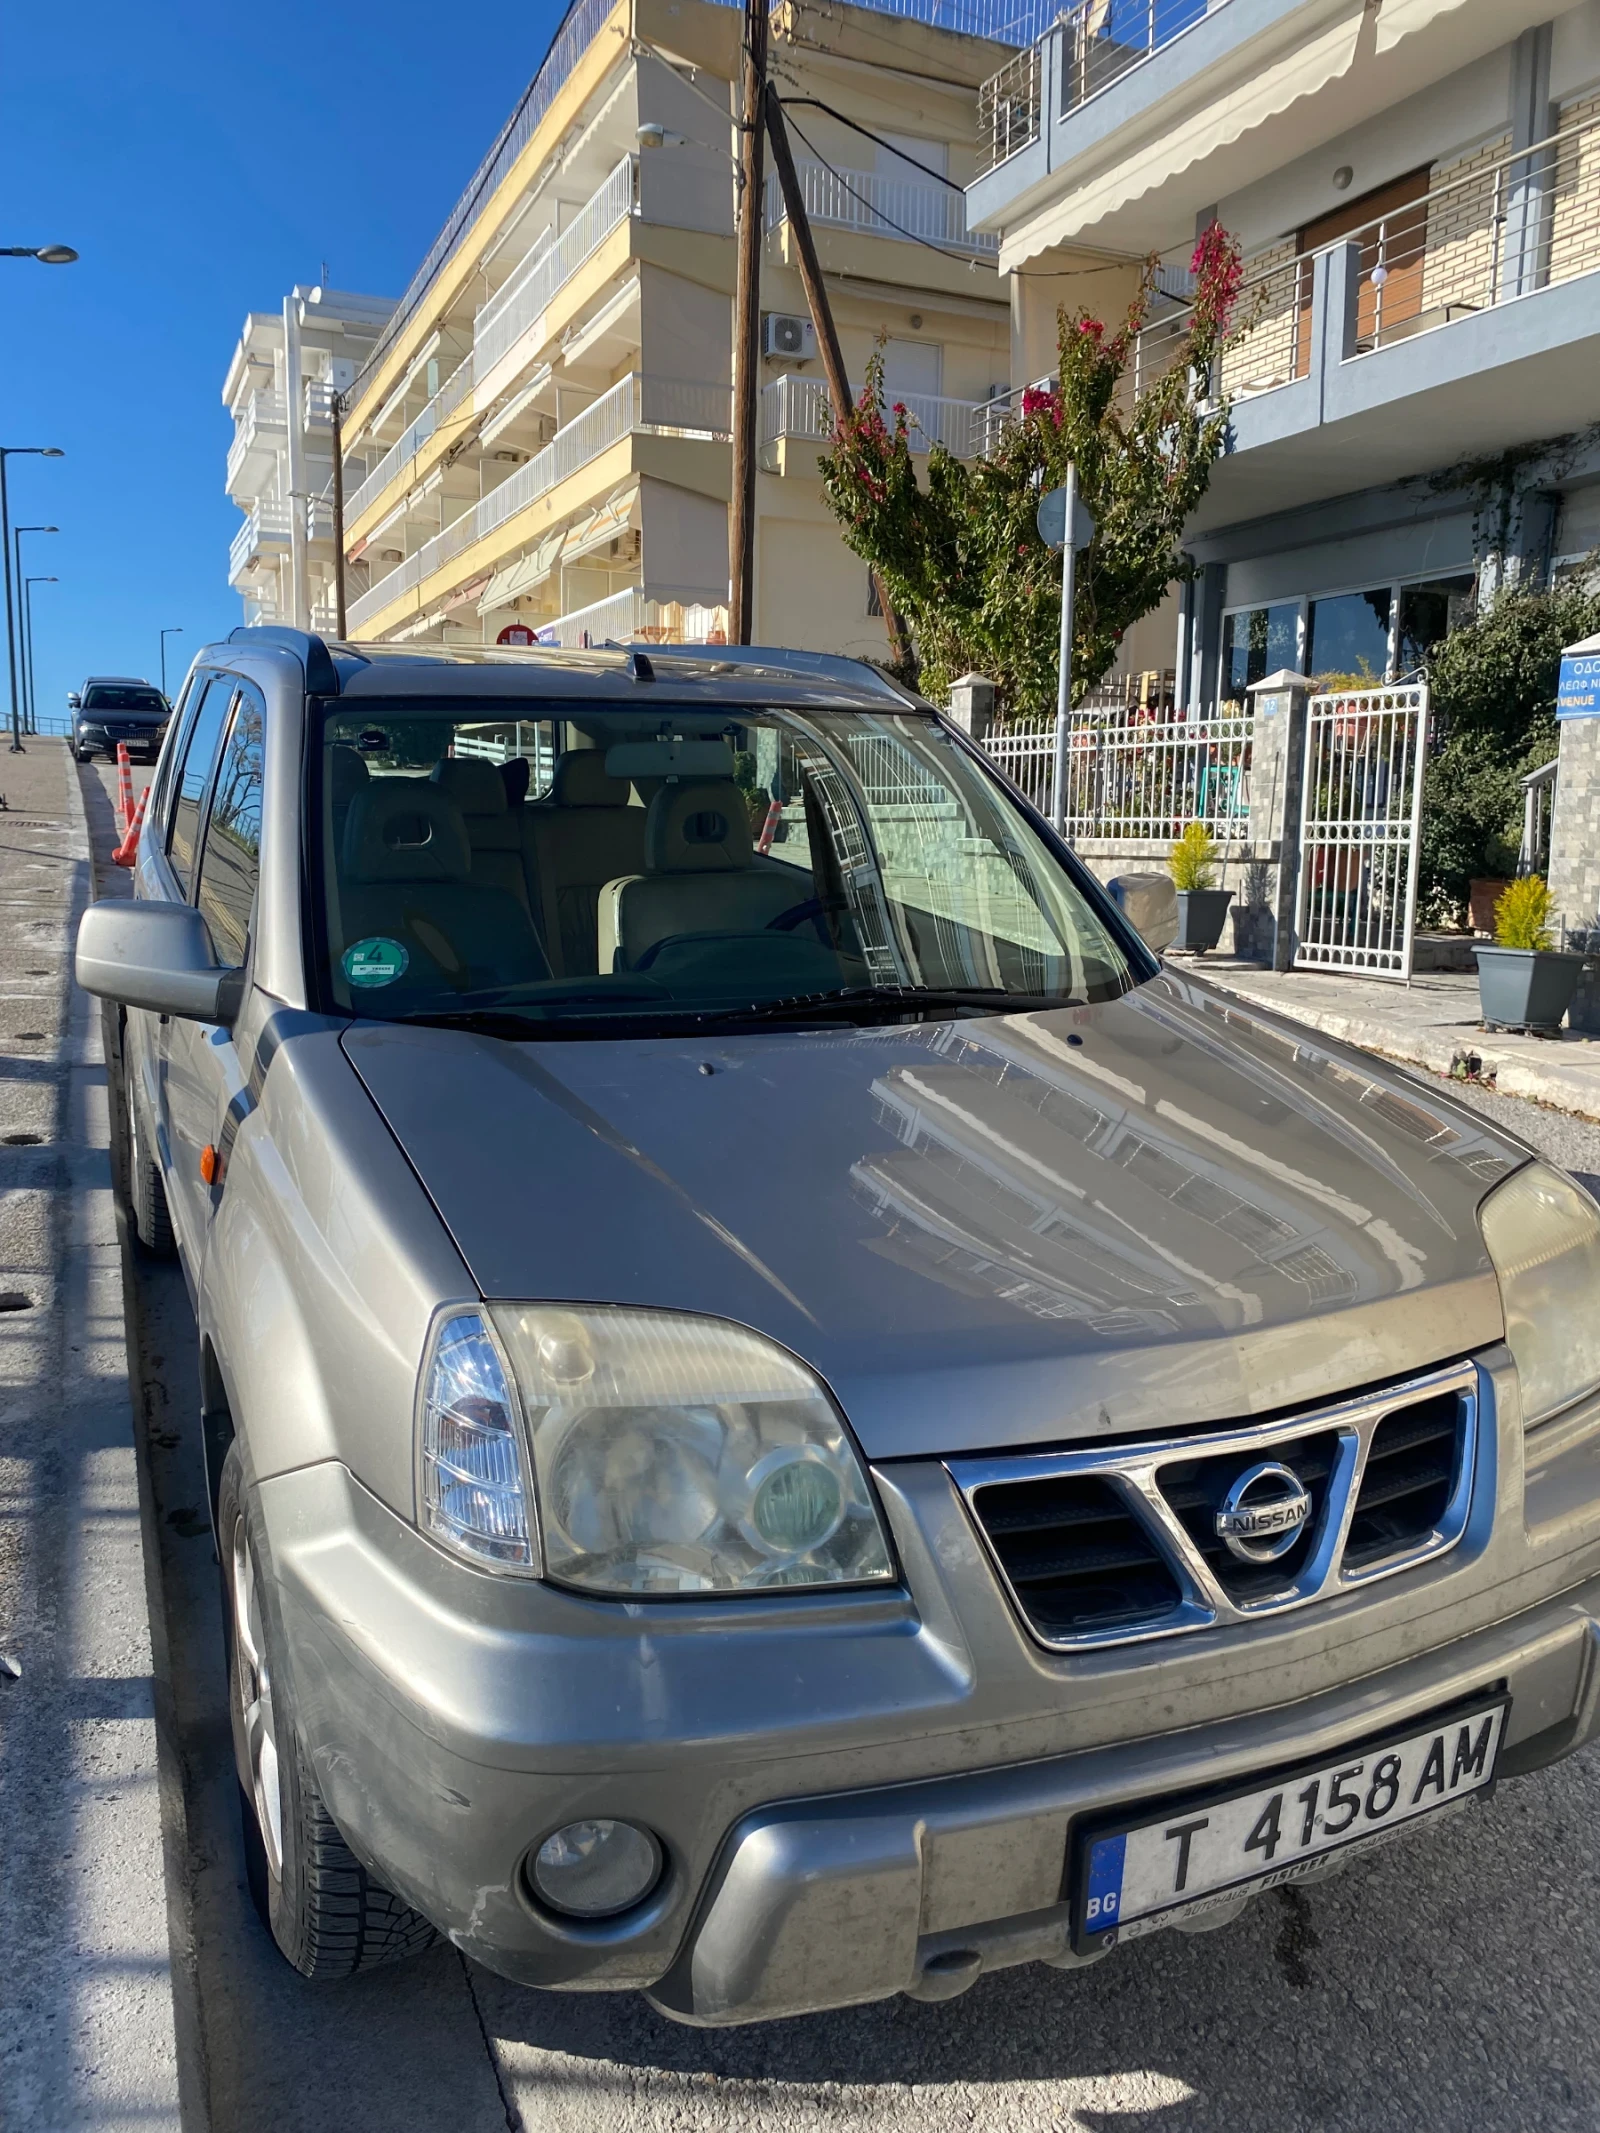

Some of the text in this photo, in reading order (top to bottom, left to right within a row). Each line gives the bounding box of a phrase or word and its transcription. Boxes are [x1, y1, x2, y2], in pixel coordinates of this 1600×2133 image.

[1266, 700, 1276, 709] 12
[1557, 695, 1594, 707] VENUE
[367, 944, 384, 962] 4
[1232, 1501, 1308, 1532] NISSAN
[1165, 1715, 1494, 1893] T 4158 AM
[1182, 1815, 1432, 1919] AUTOHAUS FISCHER ASCHAFFENBURG
[1086, 1891, 1117, 1920] BG
